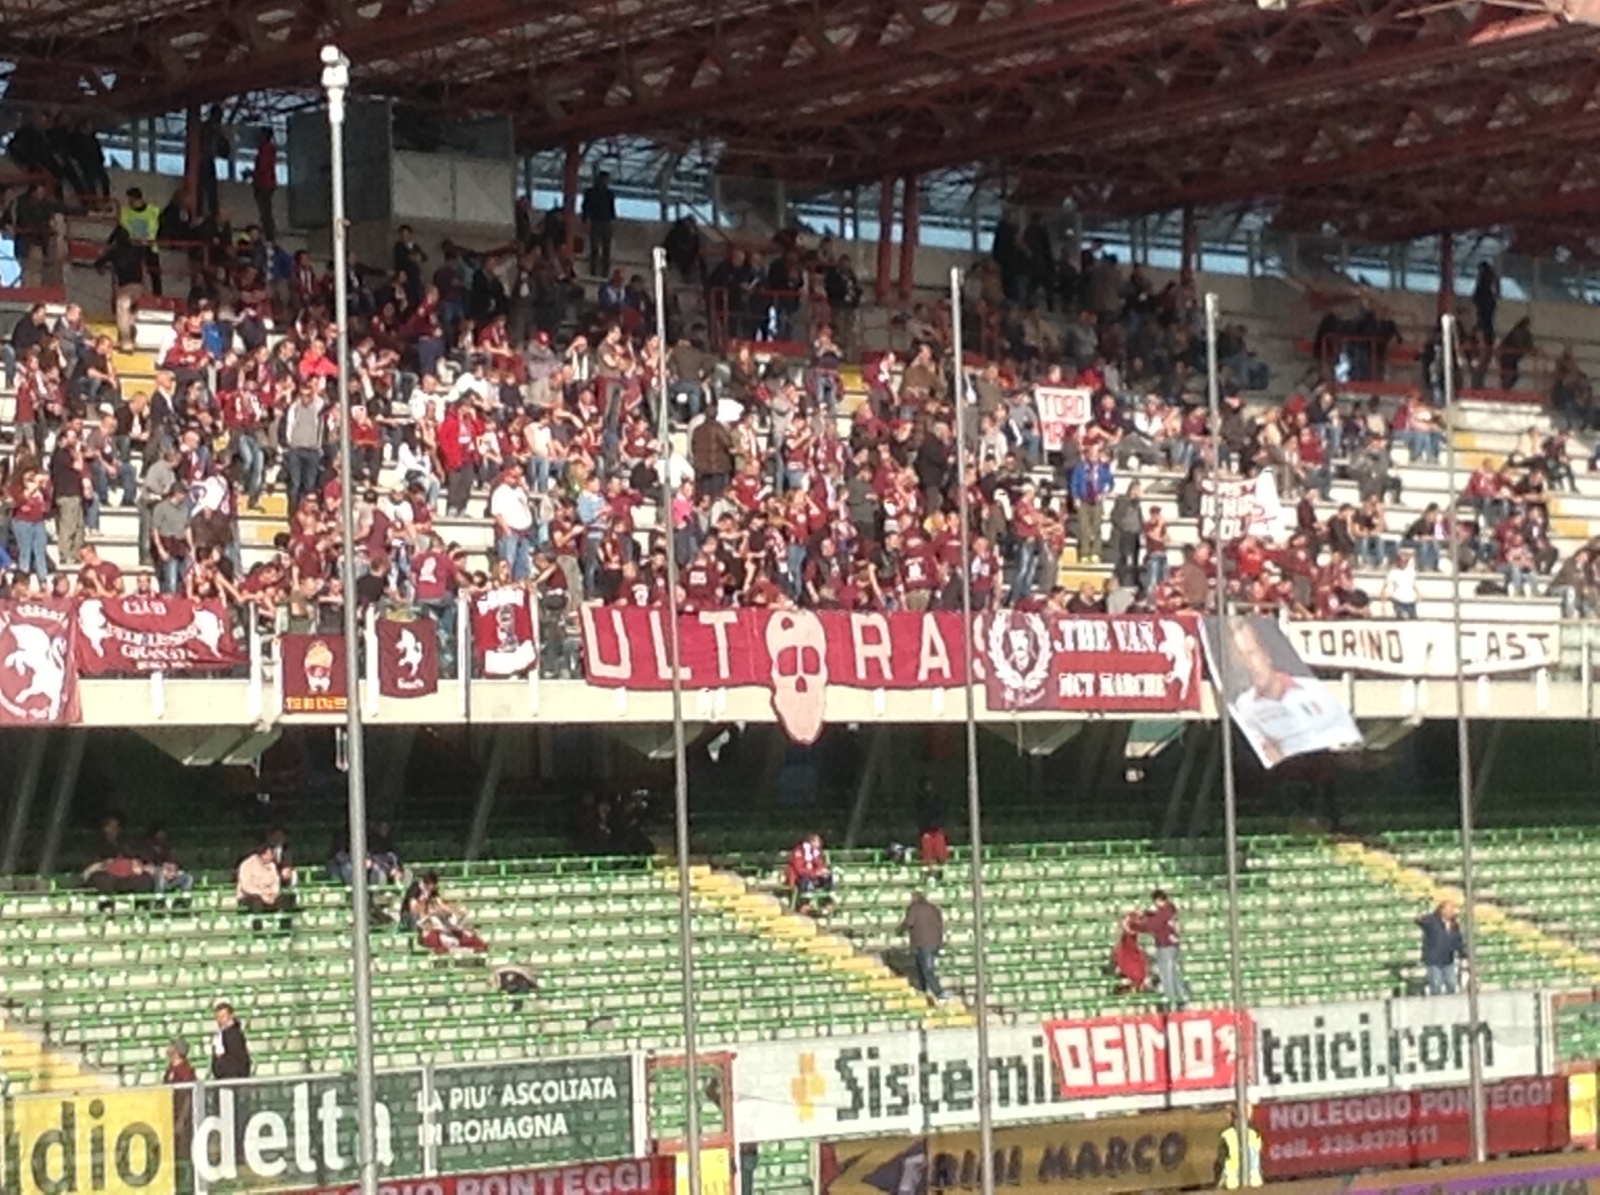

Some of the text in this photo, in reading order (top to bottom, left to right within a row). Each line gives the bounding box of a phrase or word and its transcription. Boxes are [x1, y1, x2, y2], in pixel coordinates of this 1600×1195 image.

[1040, 393, 1085, 419] TORO
[1299, 629, 1404, 663] TORINO
[1053, 1019, 1215, 1088] OSIMO
[417, 1090, 444, 1113] LA
[501, 1076, 617, 1107] ASCOLTATA
[1270, 1092, 1413, 1131] NOLEGGIO
[191, 1082, 394, 1182] delta
[417, 1113, 569, 1146] IN ROMAGNA
[1037, 1130, 1189, 1183] MARCO
[455, 1162, 651, 1195] PONTEGGI
